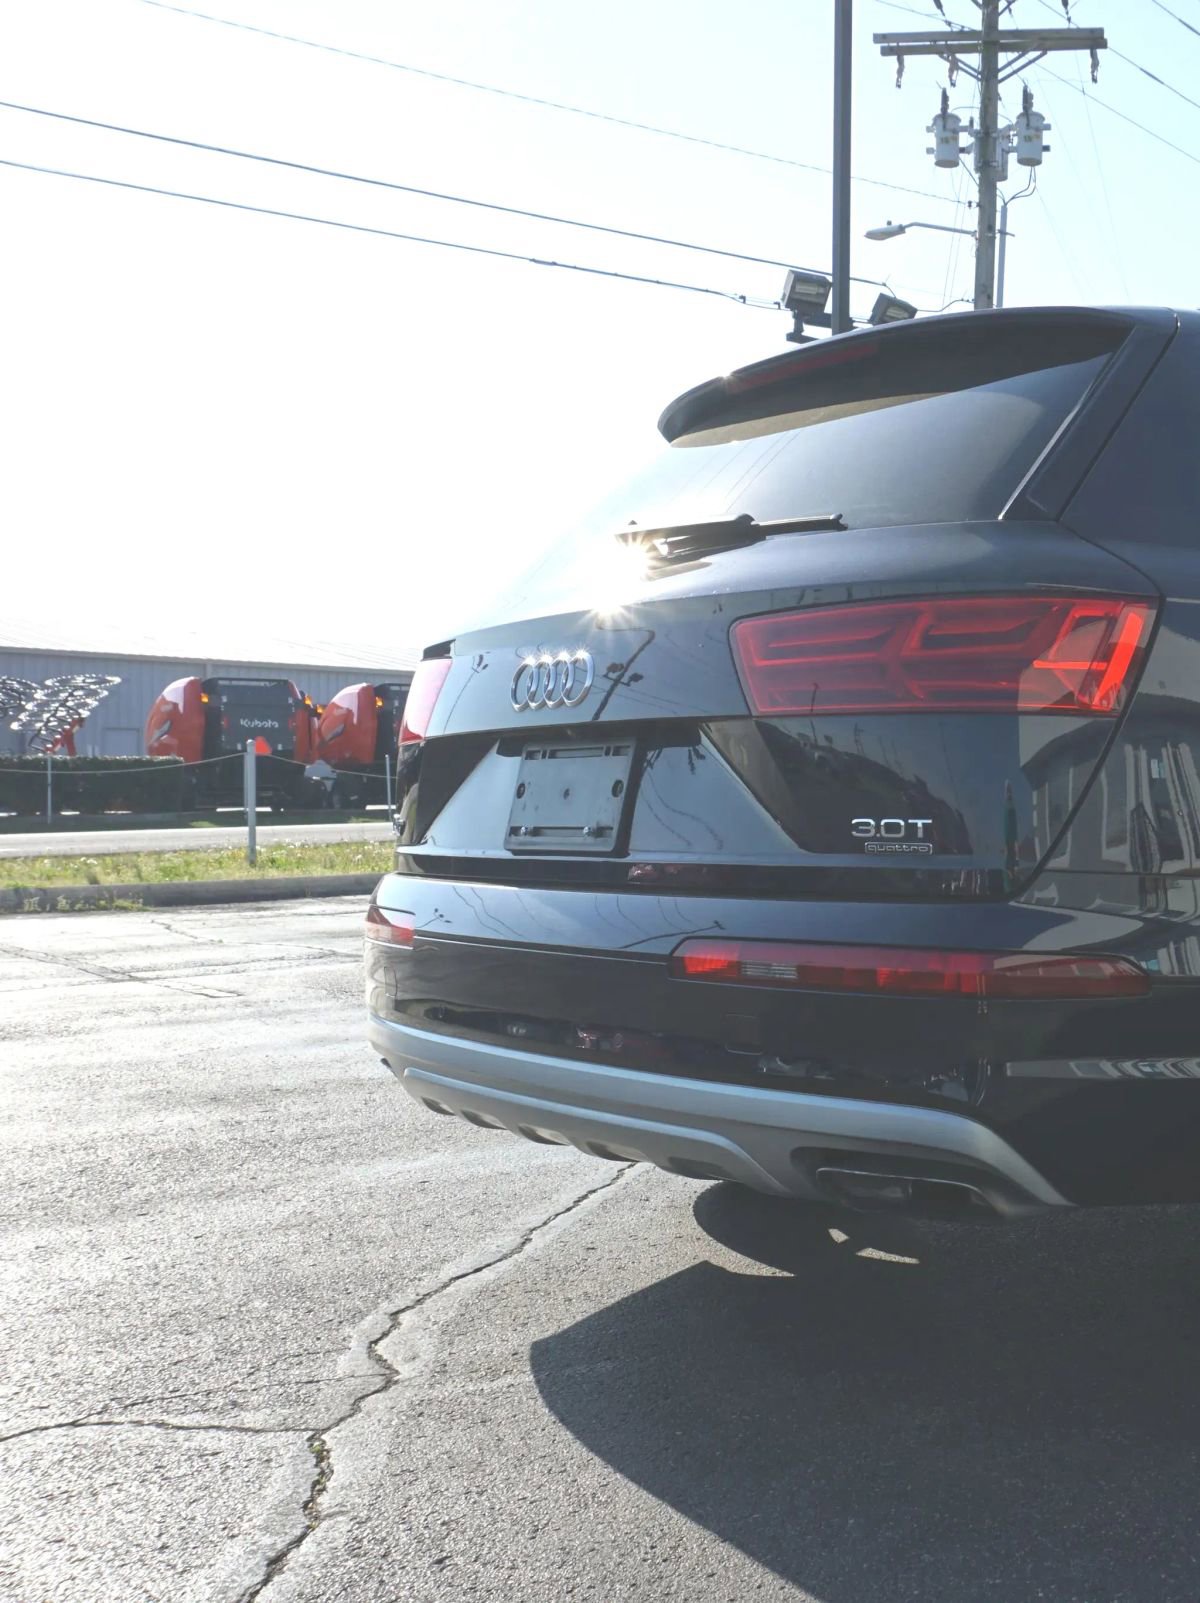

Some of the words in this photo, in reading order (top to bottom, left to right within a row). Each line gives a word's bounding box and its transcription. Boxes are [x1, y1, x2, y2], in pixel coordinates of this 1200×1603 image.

[240, 718, 279, 728] Kubota
[851, 818, 933, 838] 3.0T
[866, 843, 930, 854] quattro
